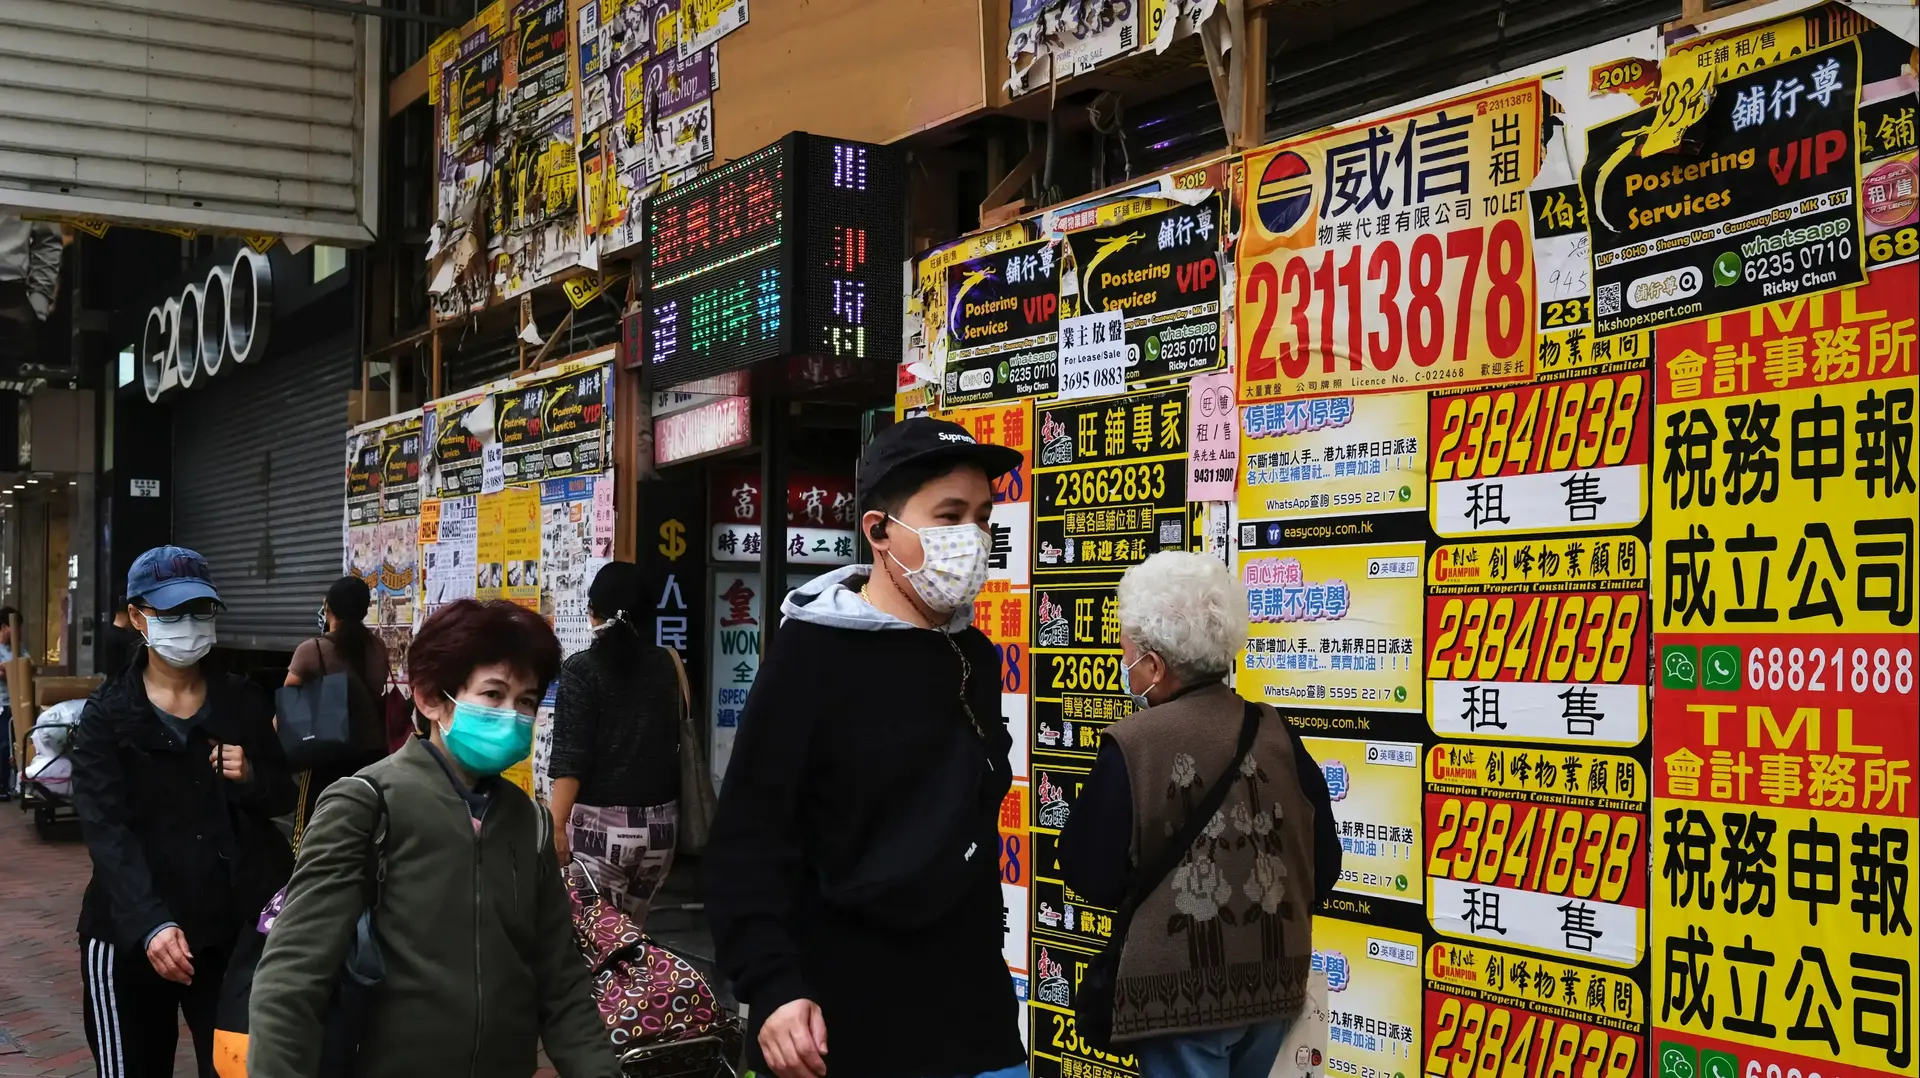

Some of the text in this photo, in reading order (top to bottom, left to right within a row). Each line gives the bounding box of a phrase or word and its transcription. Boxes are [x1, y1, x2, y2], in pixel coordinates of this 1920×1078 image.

[1120, 25, 1133, 49] 售
[1697, 44, 1730, 69] 旺舖
[1735, 30, 1776, 57] 租/售
[1597, 62, 1643, 90] 2019
[1488, 91, 1533, 112] 23113878
[1730, 57, 1844, 133] 舖行尊
[1319, 110, 1474, 220] 威信
[1488, 112, 1521, 187] 出租
[1625, 129, 1847, 197] Postering VIP
[1179, 171, 1207, 190] 2019
[1887, 167, 1907, 179] SALE
[1483, 190, 1525, 218] TO LET
[1868, 178, 1913, 205] 租/售
[1317, 198, 1472, 246] 物業代理有限公司
[1628, 187, 1732, 231] Services
[1157, 206, 1215, 251] 舖行尊
[1597, 191, 1848, 266] LKF SOHO Sheung Wan Causeway Bay MK TST
[1741, 217, 1851, 258] whatsapp
[1005, 246, 1056, 285] 舖行尊
[1101, 257, 1217, 294] Postering VIP
[1744, 237, 1852, 284] 6235 0710
[572, 276, 599, 300] 946
[1762, 269, 1837, 297] Ricky Chan
[966, 295, 1018, 319] Postering
[1023, 293, 1056, 324] VIP
[1102, 290, 1157, 313] Services
[1245, 218, 1526, 382] 23113878
[143, 247, 266, 404] G2000
[964, 321, 1008, 340] Services
[1062, 318, 1123, 350] 業主放盤
[1159, 321, 1218, 343] whatsapp
[1597, 301, 1703, 334] hkshopexpert.com
[1009, 350, 1057, 367] whatsapp
[1064, 355, 1076, 366] For
[1160, 336, 1217, 361] 6235 0710
[1168, 356, 1207, 371] Ricky Chan
[1666, 317, 1917, 399] 會計事務所
[1009, 362, 1057, 383] 6235 0710
[1061, 366, 1123, 392] 3695 0883
[1351, 366, 1465, 388] Licence No. C-022468
[1601, 358, 1647, 374] Limited
[1016, 381, 1049, 394] Ricky Chan
[1296, 377, 1343, 392] 公司牌照
[552, 403, 601, 424] Postering VIP
[709, 397, 742, 448] HOTEL
[1078, 398, 1182, 458] 旺舖專家
[1244, 396, 1350, 434] 停課不停學
[1431, 374, 1644, 482] 23841838
[1192, 448, 1236, 463] 吳先生 Alan
[1246, 437, 1418, 470] 不斷增加人手... 港九新界日日派送
[1663, 387, 1917, 511] 稅務申報
[1055, 463, 1165, 506] 23662833
[1193, 467, 1235, 484] 94311900
[1246, 464, 1331, 486] 各大小型補習社...
[1265, 490, 1396, 511] WhatsApp查詢 5595 2217
[1464, 471, 1607, 530] 租 售
[659, 518, 687, 562] $
[717, 530, 853, 558] 時鐘夜二樓
[1284, 520, 1374, 540] easycopy.com.hk
[1081, 538, 1147, 562] 歡迎委託
[1435, 548, 1480, 582] CHAMPION
[1487, 540, 1637, 581] 創峰物業顧問
[1246, 564, 1300, 585] 同心抗疫
[1430, 579, 1644, 595] Champion Property Consultants Limited
[1662, 517, 1914, 628] 成立公司
[719, 578, 758, 628] 皇
[1246, 585, 1346, 617] 停課不停學
[1245, 638, 1413, 655] 不斷增加人手... 港九新界日日派送
[1427, 594, 1641, 682] 23841838
[732, 661, 754, 683] 全
[1245, 654, 1327, 670] 各大小型補習社...
[1747, 646, 1914, 694] 68821888
[1264, 684, 1391, 700] WhatsApp查詢 5595 2217
[1460, 685, 1605, 736] 租 售
[1686, 703, 1884, 755] TML
[1432, 747, 1477, 781] CHAMPION
[1485, 750, 1635, 799] 創峰物業顧問
[1663, 746, 1912, 814] 會計事務所
[1427, 783, 1643, 812] Champion Property Consultants Limited
[1427, 798, 1639, 903] 23841838
[1362, 872, 1393, 888] 2217
[1662, 807, 1913, 938] 稅務申報
[1080, 911, 1113, 938] 歡迎
[1461, 888, 1603, 952] 租 售
[1432, 945, 1477, 983] CHAMPION
[1484, 954, 1633, 1020] 創峰物業顧問
[1661, 924, 1912, 1069] 成立公司
[1427, 981, 1641, 1033] Champion Property Consultants Limited
[1328, 1058, 1358, 1075] 5595
